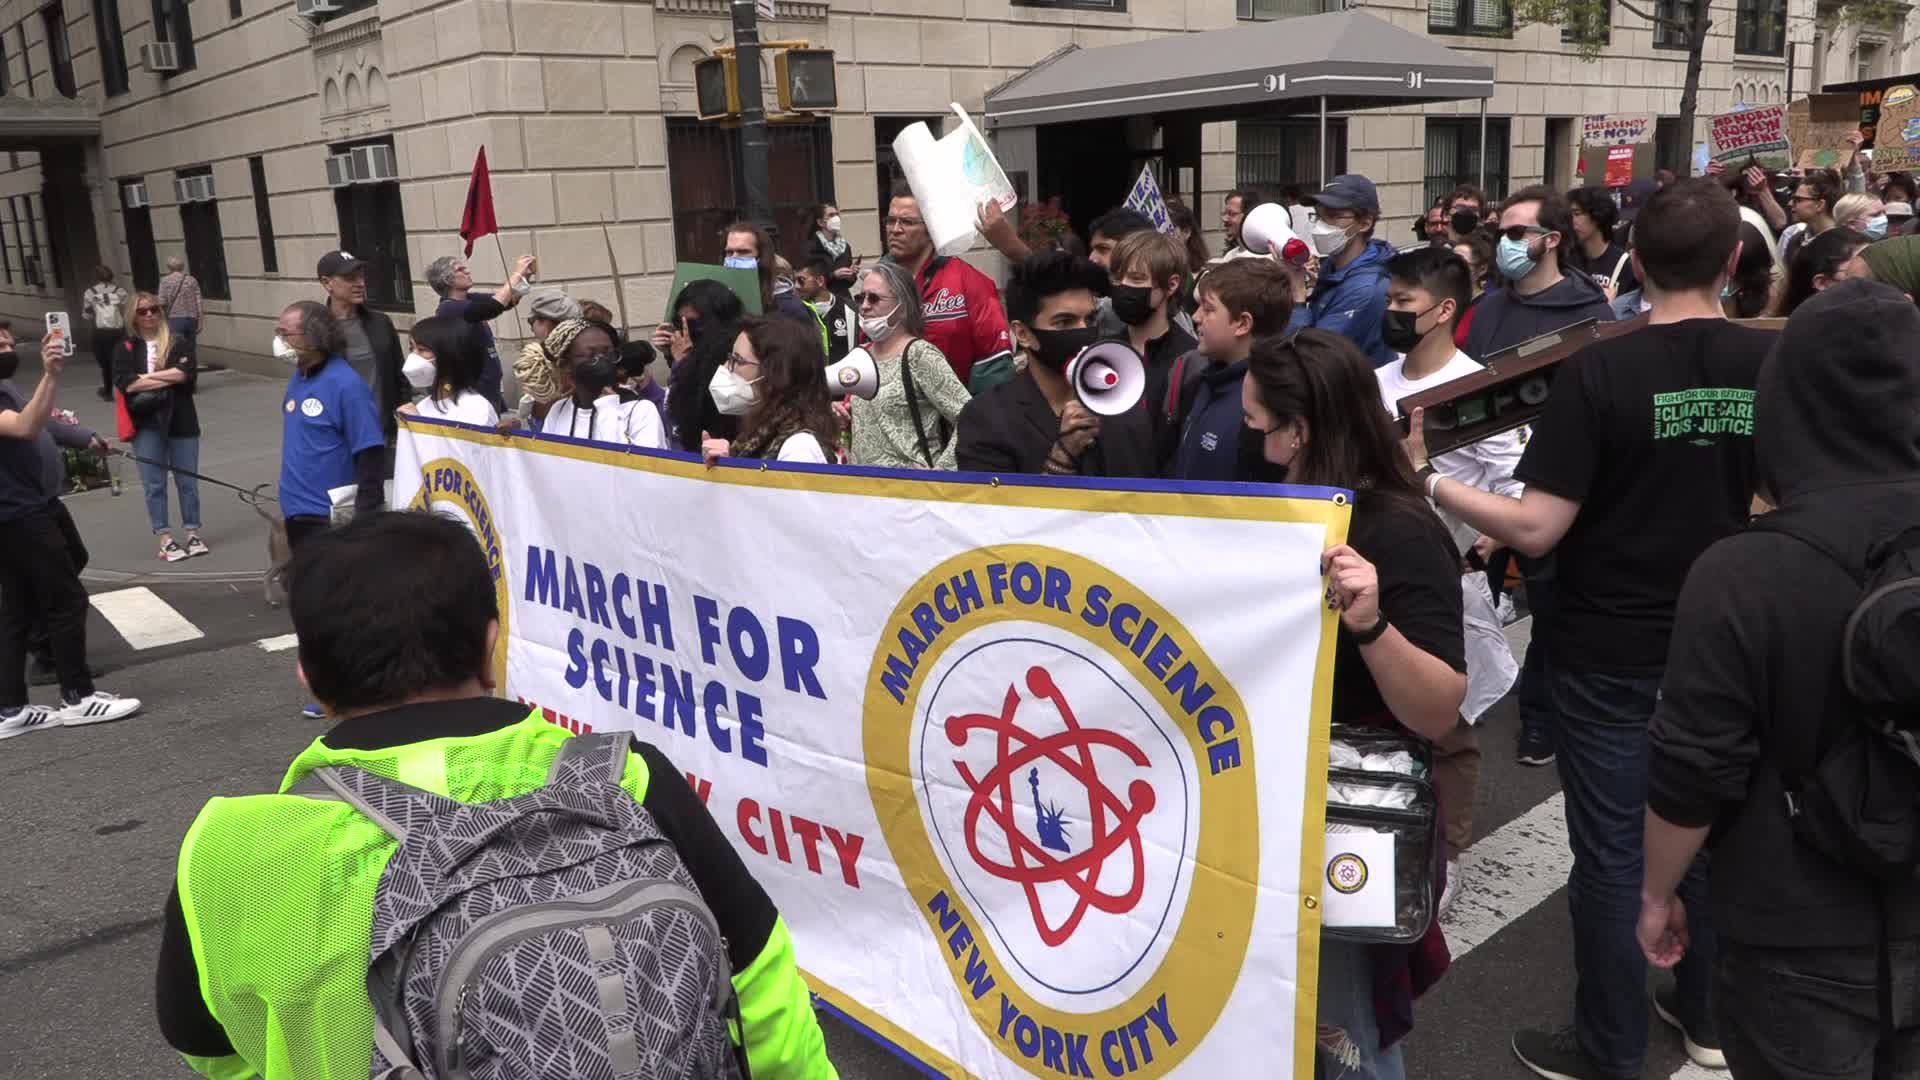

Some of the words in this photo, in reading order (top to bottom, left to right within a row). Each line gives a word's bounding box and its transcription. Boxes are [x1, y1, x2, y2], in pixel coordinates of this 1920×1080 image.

[1263, 73, 1286, 93] 91
[1407, 71, 1422, 89] 91
[1734, 106, 1783, 124] NORTH
[1584, 131, 1600, 140] IS
[1711, 118, 1781, 141] BROOKLYN
[1716, 131, 1782, 151] PIPELINE
[1699, 390, 1719, 399] OUR
[434, 467, 462, 497] FOR
[525, 545, 675, 652] MARCH
[692, 594, 827, 700] FOR
[880, 570, 985, 705] MARCH
[986, 561, 1072, 614] FOR
[1080, 584, 1241, 776] SCIENCE
[564, 628, 768, 768] SCIENCE
[736, 797, 865, 890] CITY
[927, 890, 996, 1001] NEW
[997, 992, 1094, 1079] YORK
[1101, 992, 1179, 1078] CITY
